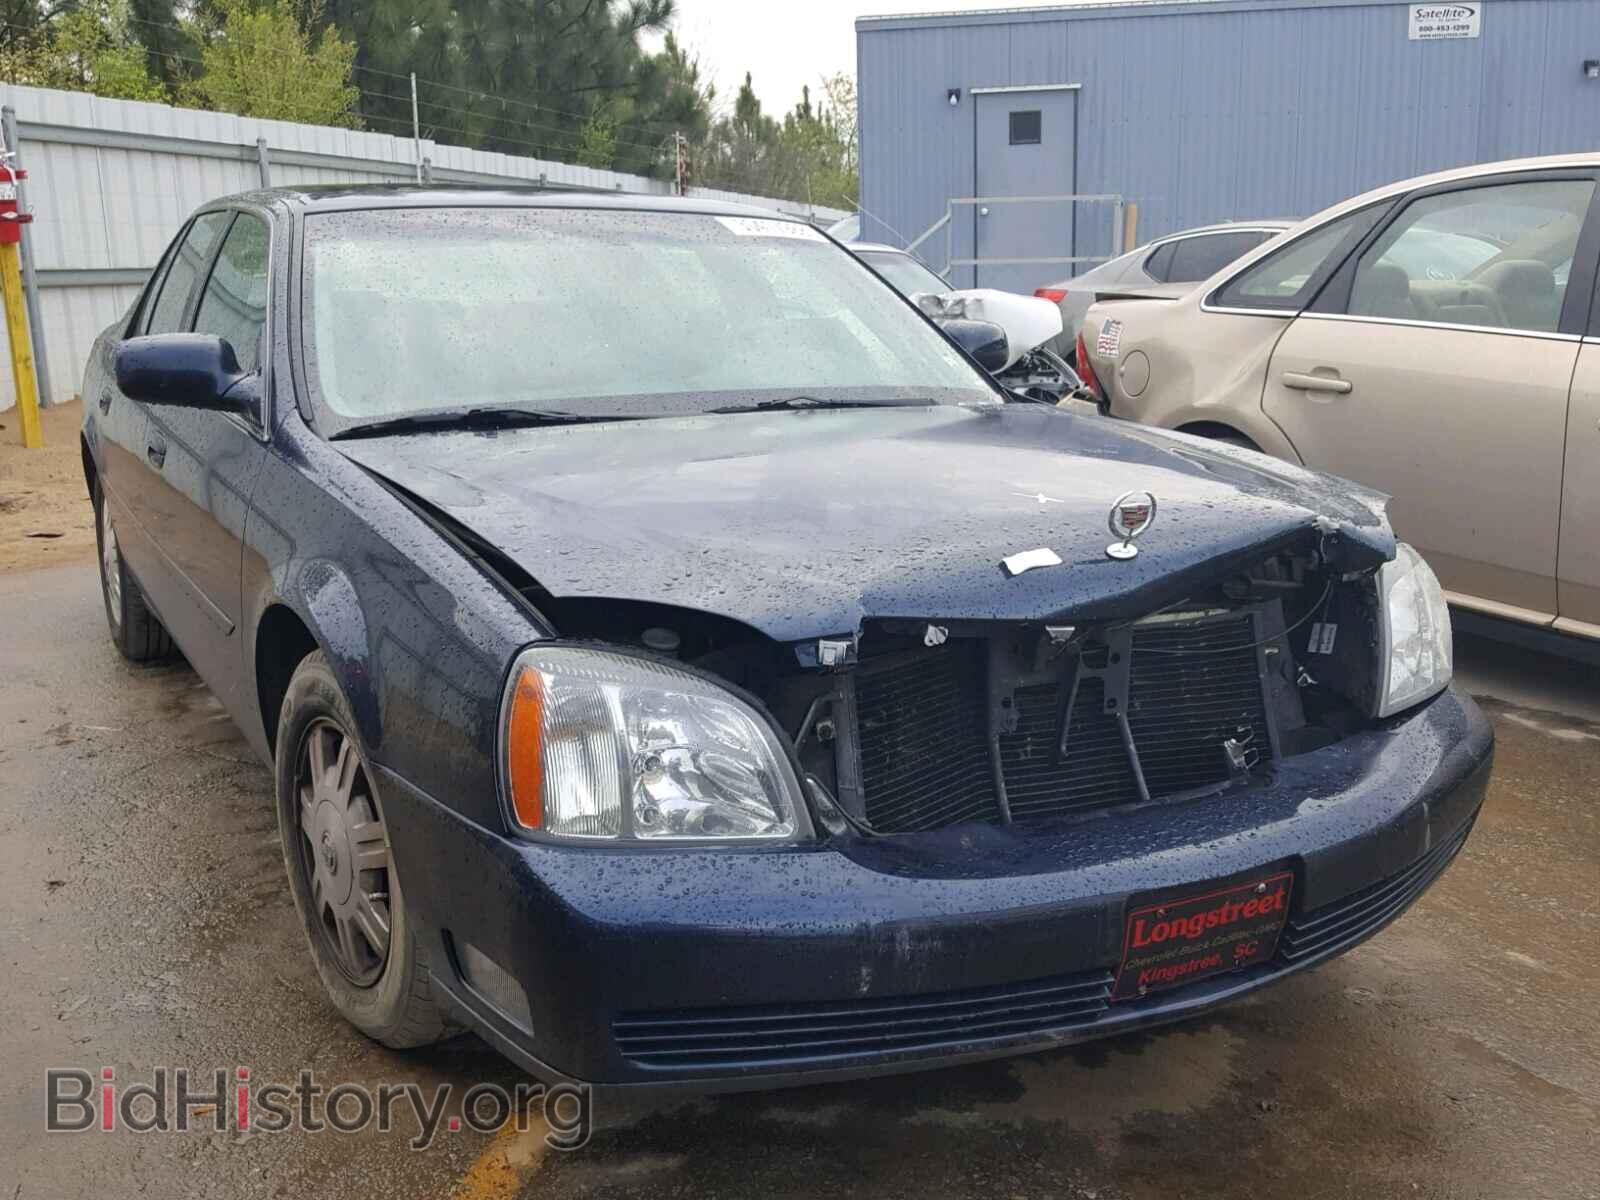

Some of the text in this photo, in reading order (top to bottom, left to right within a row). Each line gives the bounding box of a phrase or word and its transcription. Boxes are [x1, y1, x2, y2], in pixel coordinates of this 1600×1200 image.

[1416, 7, 1466, 18] Satellite
[1132, 885, 1286, 948] Longstreet
[1233, 940, 1258, 959] SC
